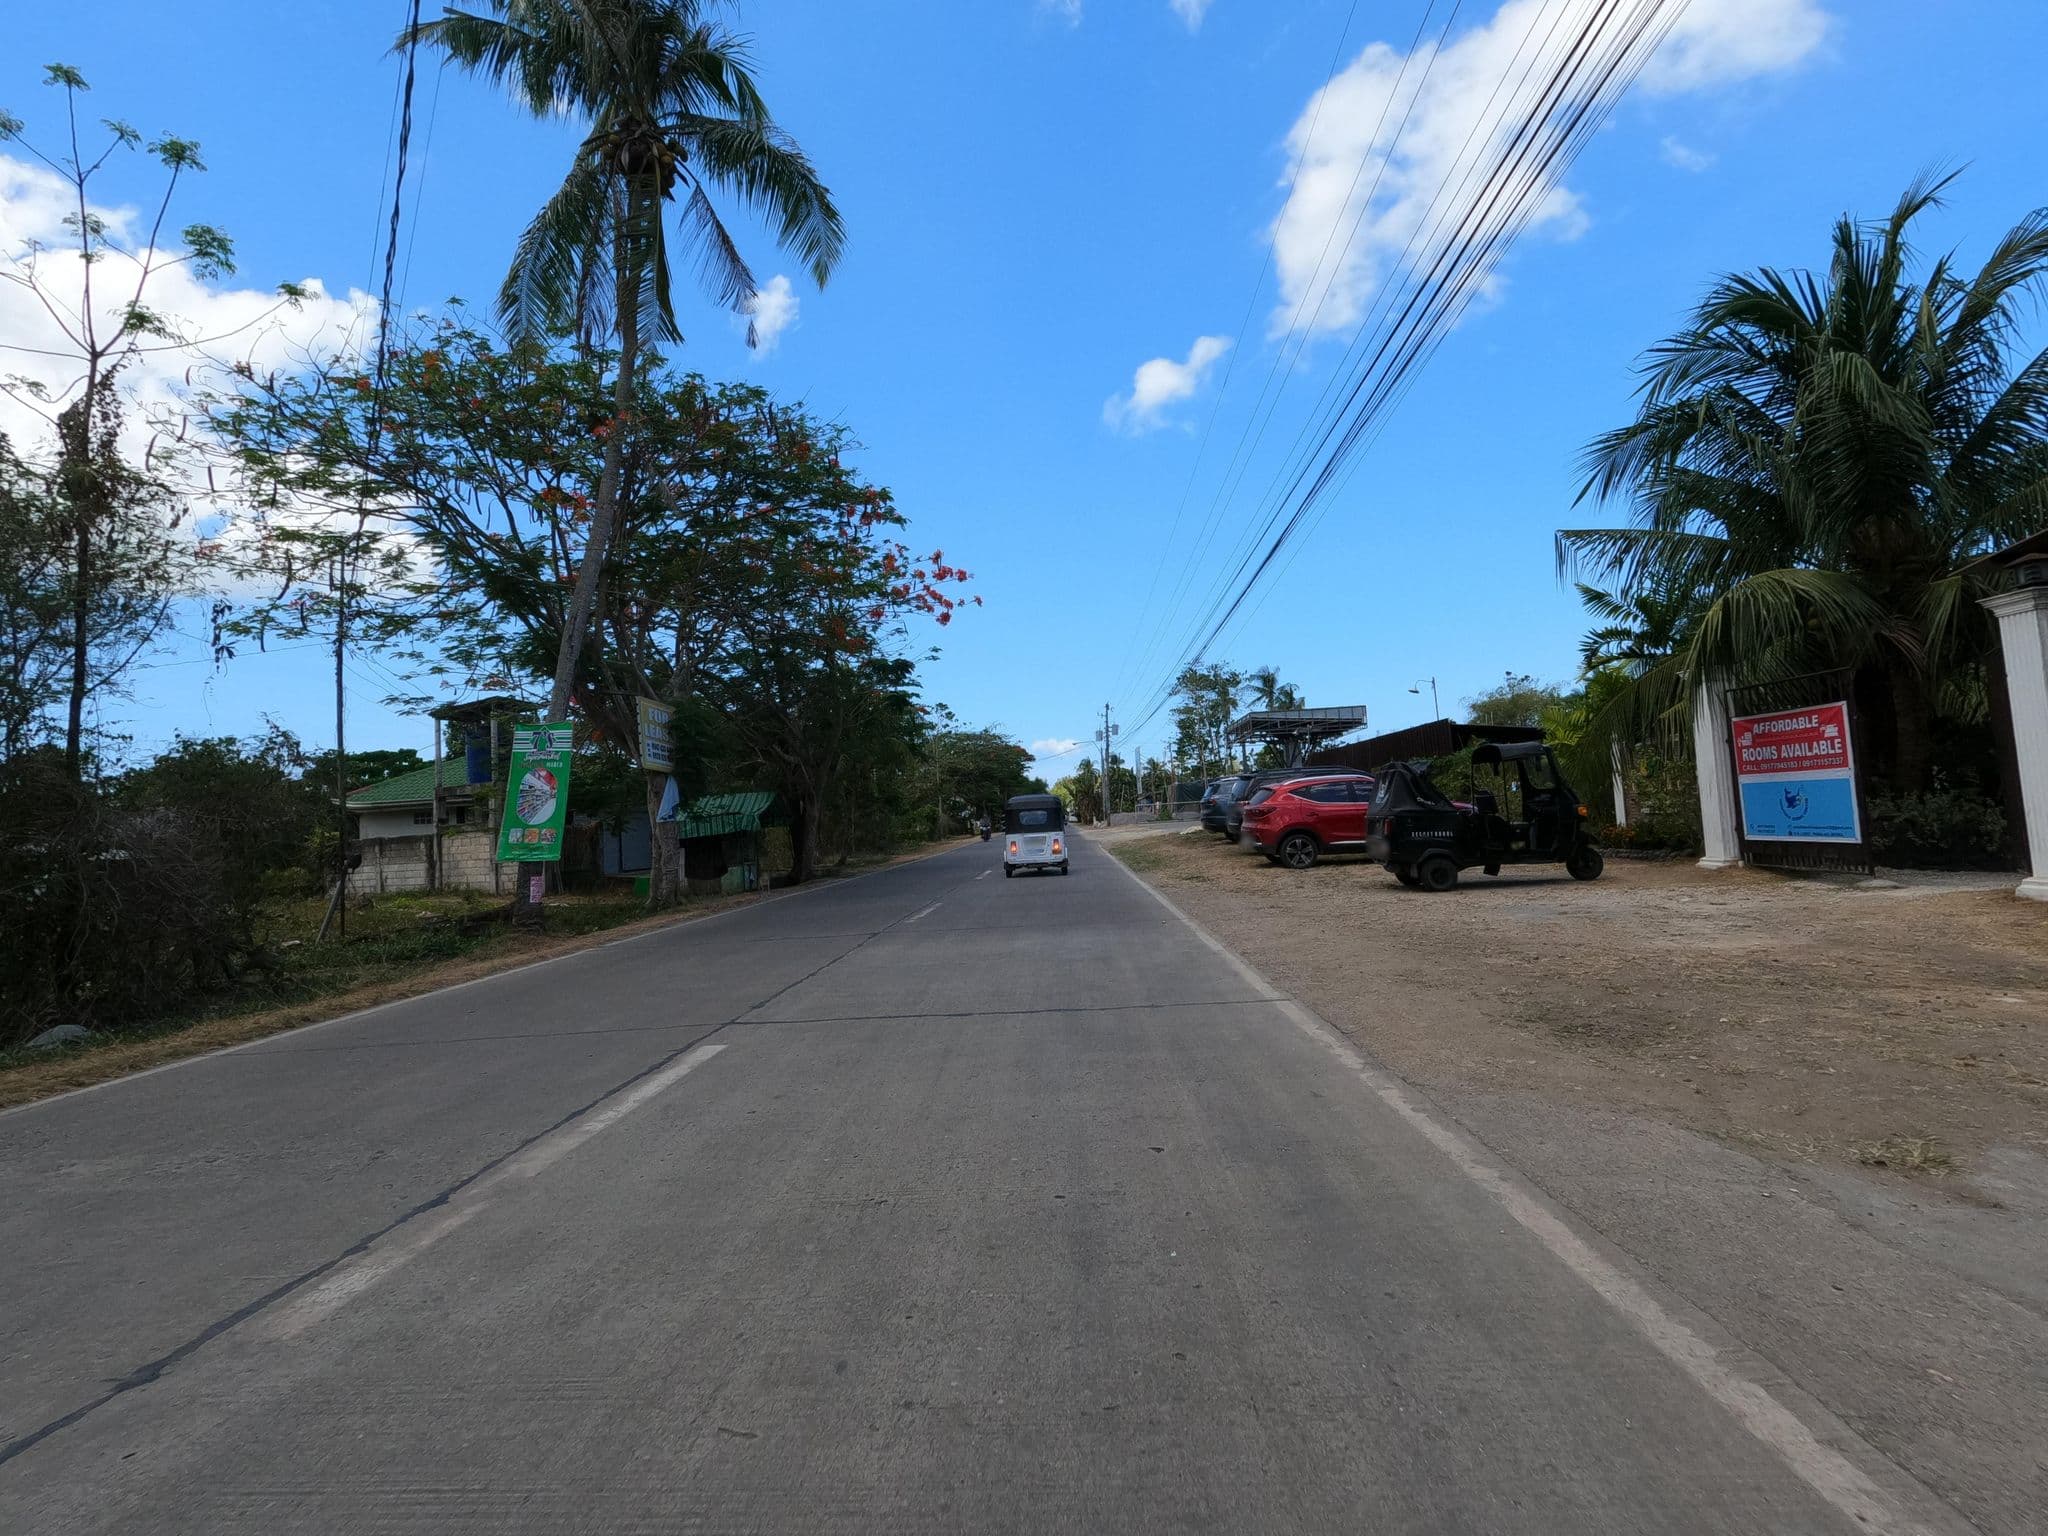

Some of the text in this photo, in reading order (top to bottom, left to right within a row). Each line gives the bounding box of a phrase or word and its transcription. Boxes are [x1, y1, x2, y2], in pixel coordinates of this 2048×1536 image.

[1753, 714, 1819, 735] AFFORDABLE
[1742, 738, 1843, 762] ROOMS AVAILABLE
